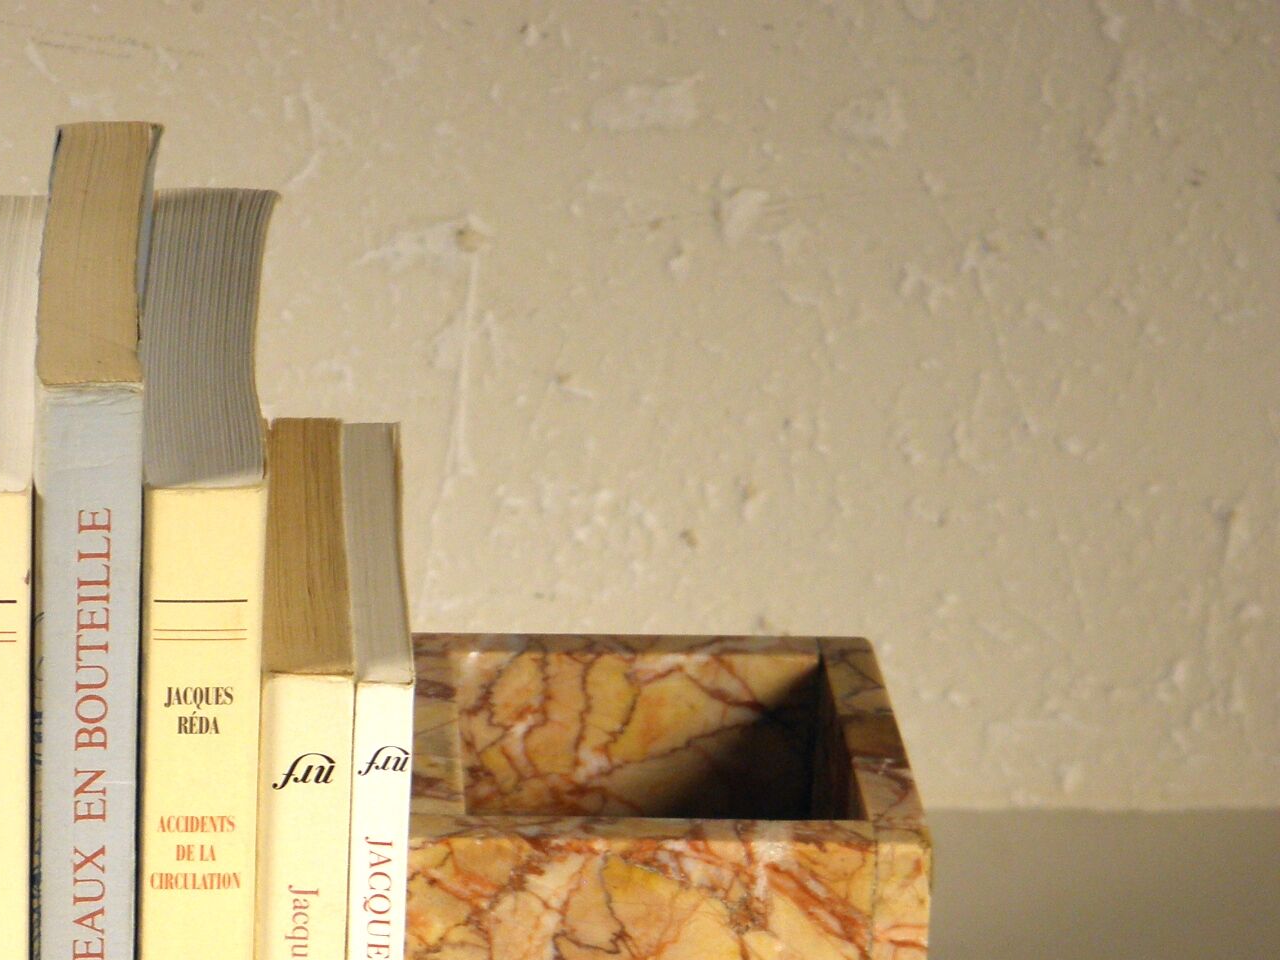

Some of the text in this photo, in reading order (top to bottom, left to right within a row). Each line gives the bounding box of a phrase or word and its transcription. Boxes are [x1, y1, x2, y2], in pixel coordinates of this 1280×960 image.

[75, 508, 111, 750] BOUTEILLE
[164, 686, 234, 708] JACQUES
[177, 711, 220, 735] RÉDA
[74, 769, 106, 822] EN
[156, 815, 235, 833] ACCIDENTS
[176, 845, 216, 861] DE LA
[150, 873, 240, 890] CIRCULATION
